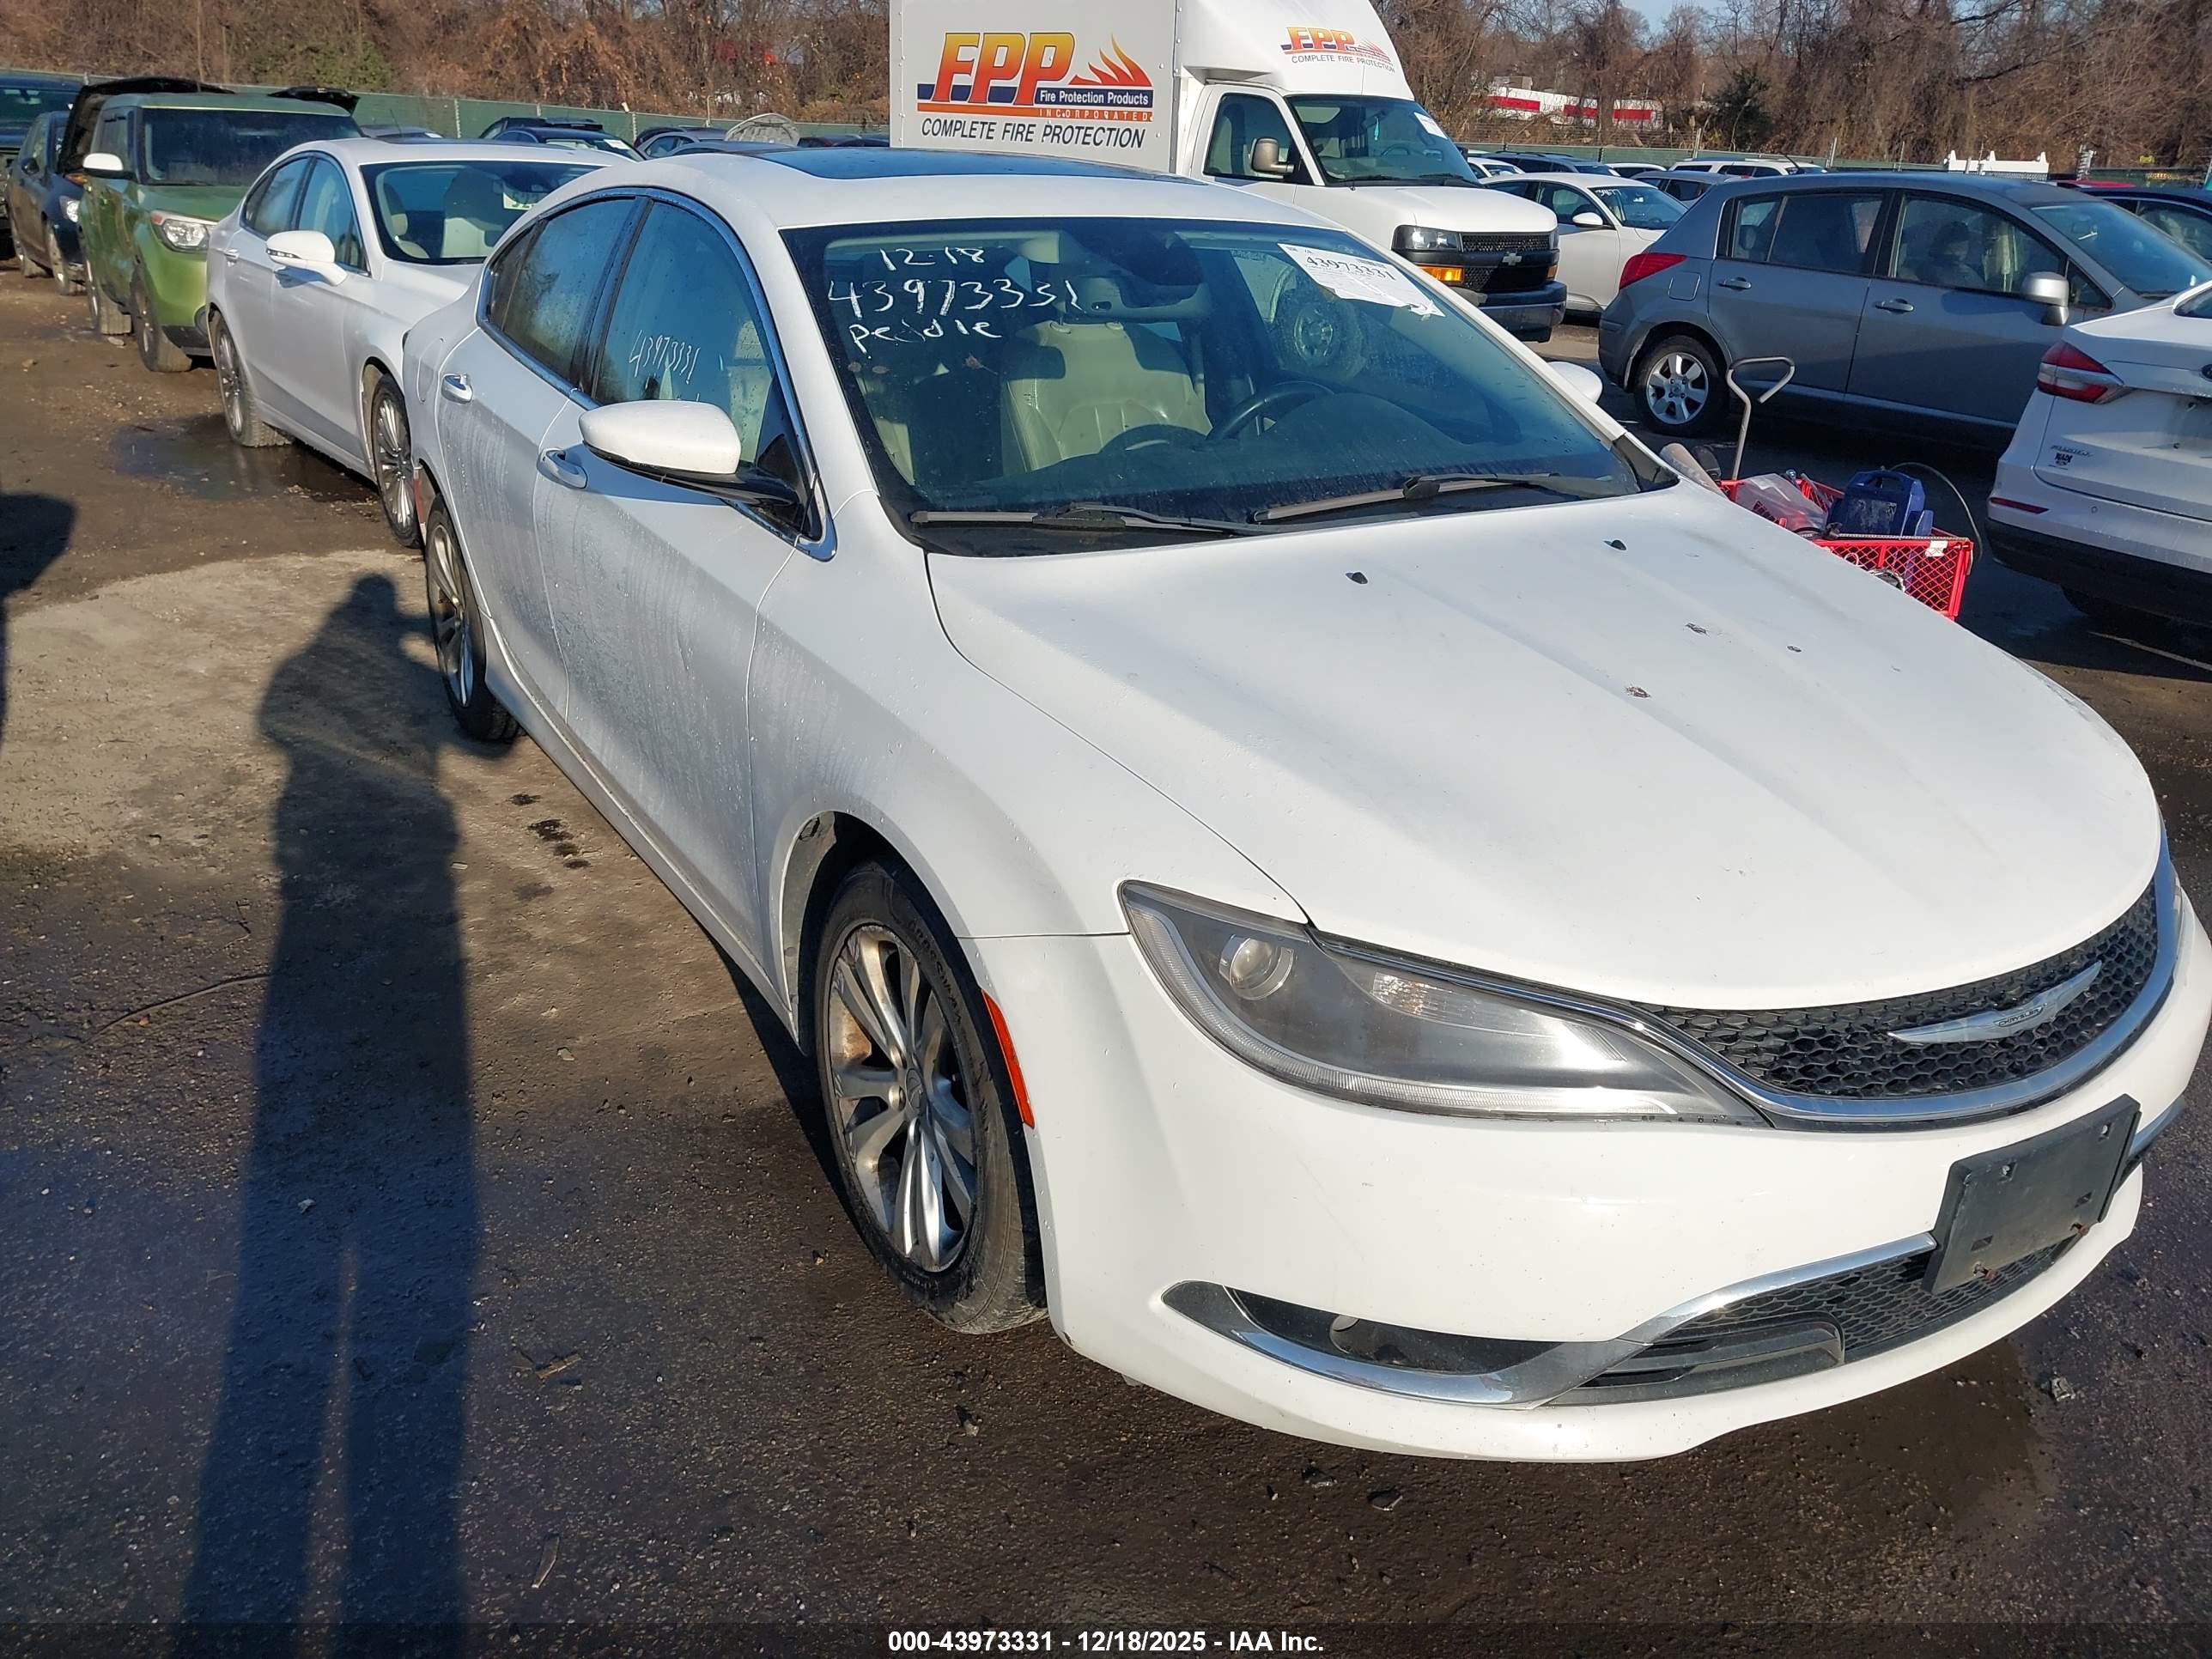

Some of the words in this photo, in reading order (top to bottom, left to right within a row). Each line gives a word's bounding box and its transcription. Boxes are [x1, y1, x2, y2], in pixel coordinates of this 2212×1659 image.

[1286, 27, 1355, 51] FPP
[932, 33, 1074, 105] FPP
[1291, 54, 1336, 64] COMPLETE
[1337, 55, 1355, 64] FIRE
[1357, 57, 1395, 73] PROTECTION
[1040, 89, 1056, 102] Fire
[1059, 90, 1104, 104] Protection
[1107, 93, 1149, 106] Products
[921, 117, 997, 140] COMPLETE
[1001, 123, 1036, 143] FIRE
[1042, 125, 1146, 149] PROTECTION
[1306, 257, 1397, 281] 43973331
[828, 278, 1088, 318] 43973331
[629, 330, 701, 382] 43973331
